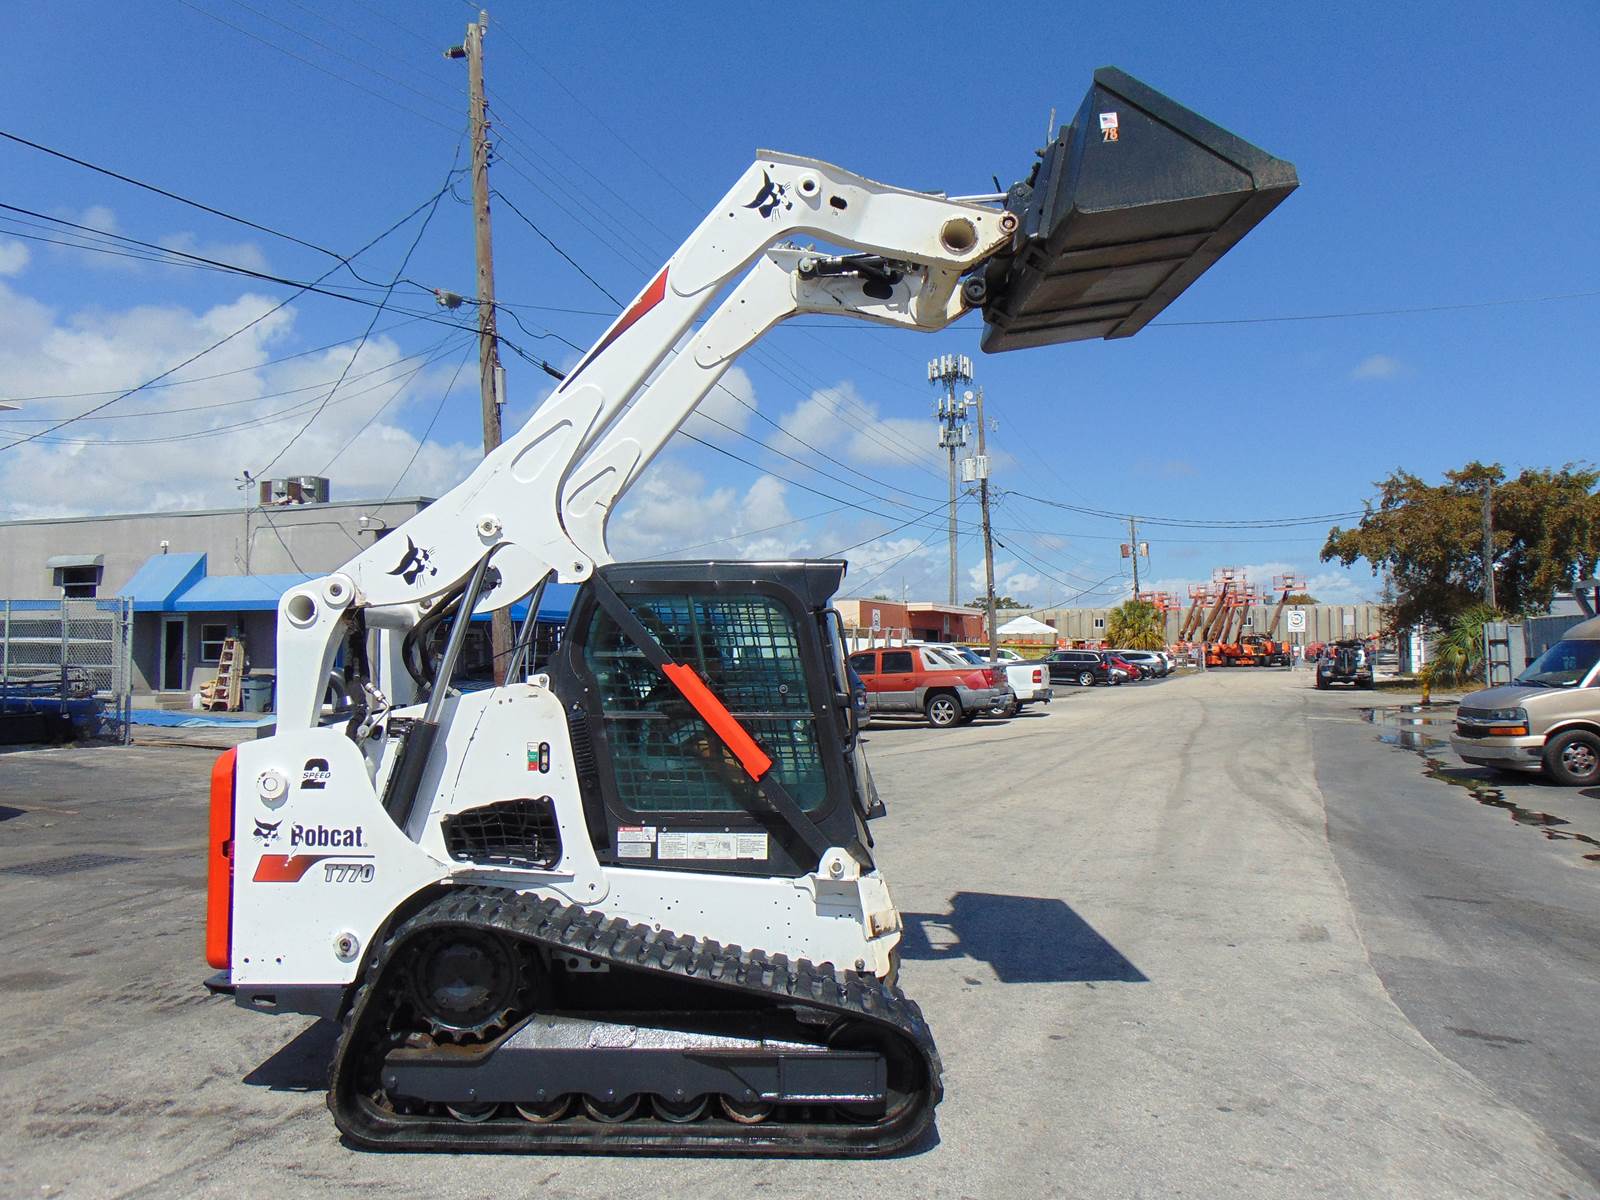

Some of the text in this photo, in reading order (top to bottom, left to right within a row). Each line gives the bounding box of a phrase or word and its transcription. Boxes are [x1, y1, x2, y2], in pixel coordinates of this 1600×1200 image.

[302, 771, 331, 779] SPEED
[290, 825, 363, 847] Bobcat
[324, 863, 375, 883] T770
